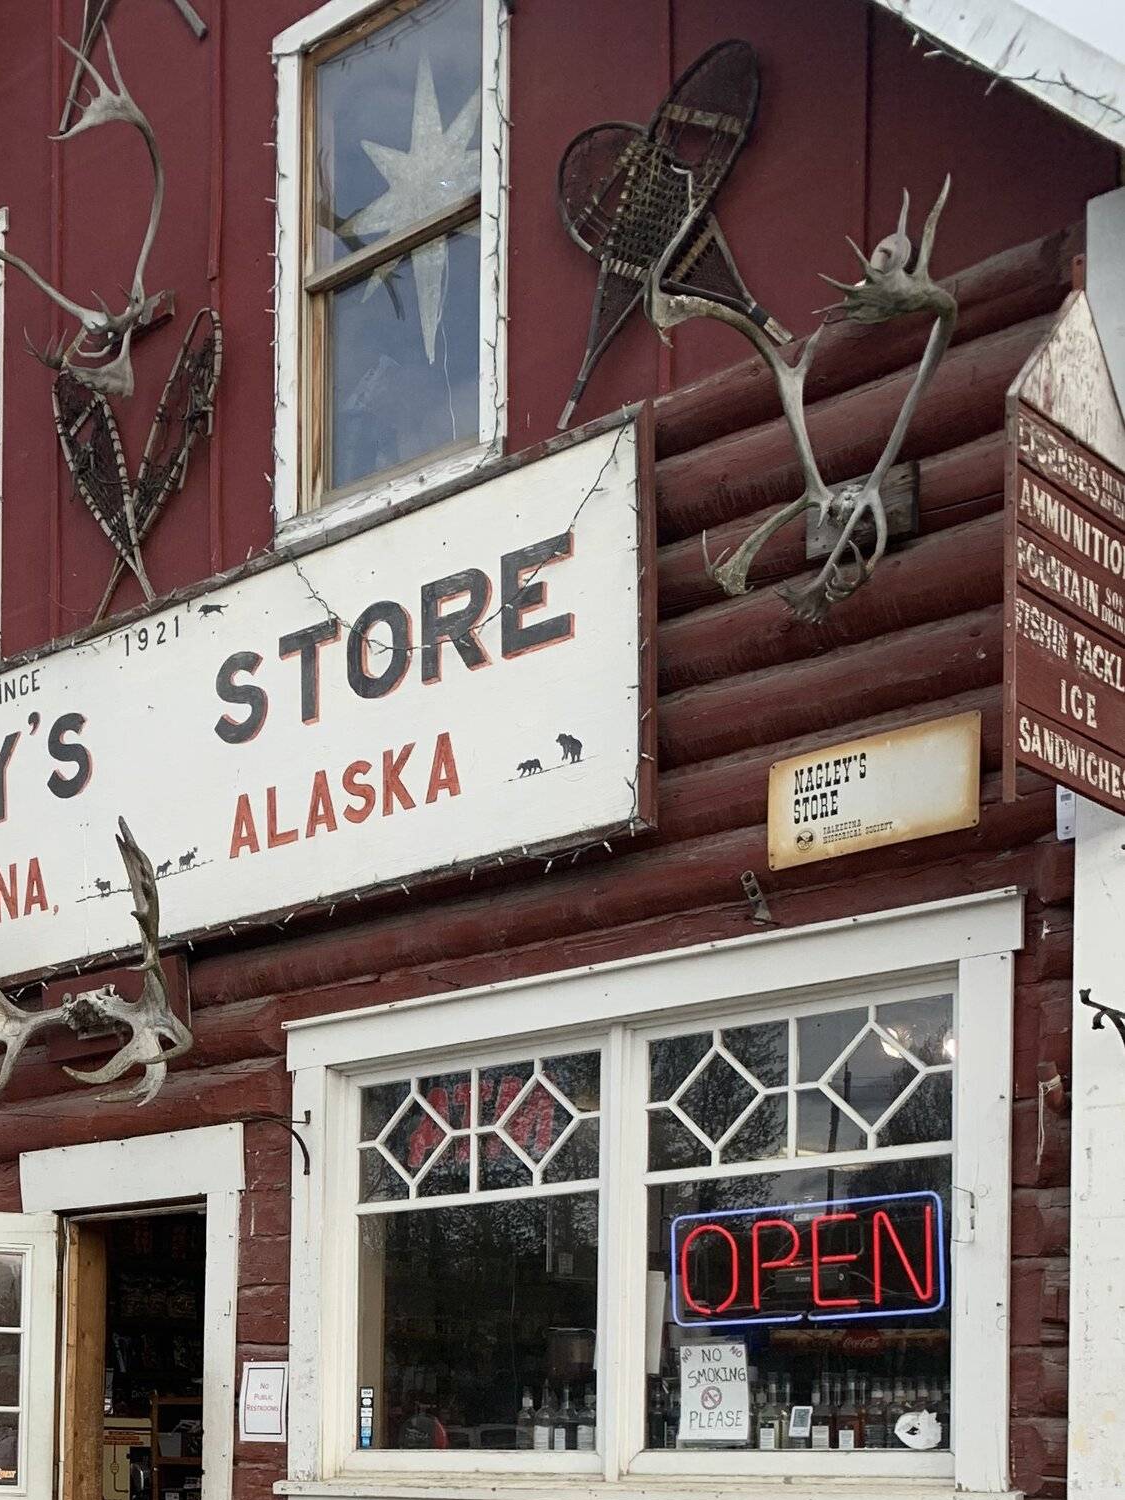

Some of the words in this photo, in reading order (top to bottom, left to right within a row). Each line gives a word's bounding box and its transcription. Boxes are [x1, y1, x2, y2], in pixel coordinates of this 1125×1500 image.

[1018, 478, 1125, 580] AMMUNITIO
[1017, 536, 1099, 617] FOUNTAIN
[124, 625, 181, 658] 1921
[214, 532, 575, 745] STORE
[1060, 679, 1097, 729] ICE
[794, 752, 867, 795] NAGLEY'S
[1018, 716, 1125, 801] SANDWICHE
[230, 732, 461, 859] ALASKA
[793, 789, 839, 824] STORE
[865, 821, 893, 835] SOCIETY
[681, 1204, 934, 1315] OPEN
[687, 1366, 747, 1388] SMOKING
[701, 1348, 723, 1362] NO
[689, 1410, 743, 1430] PLEASE
